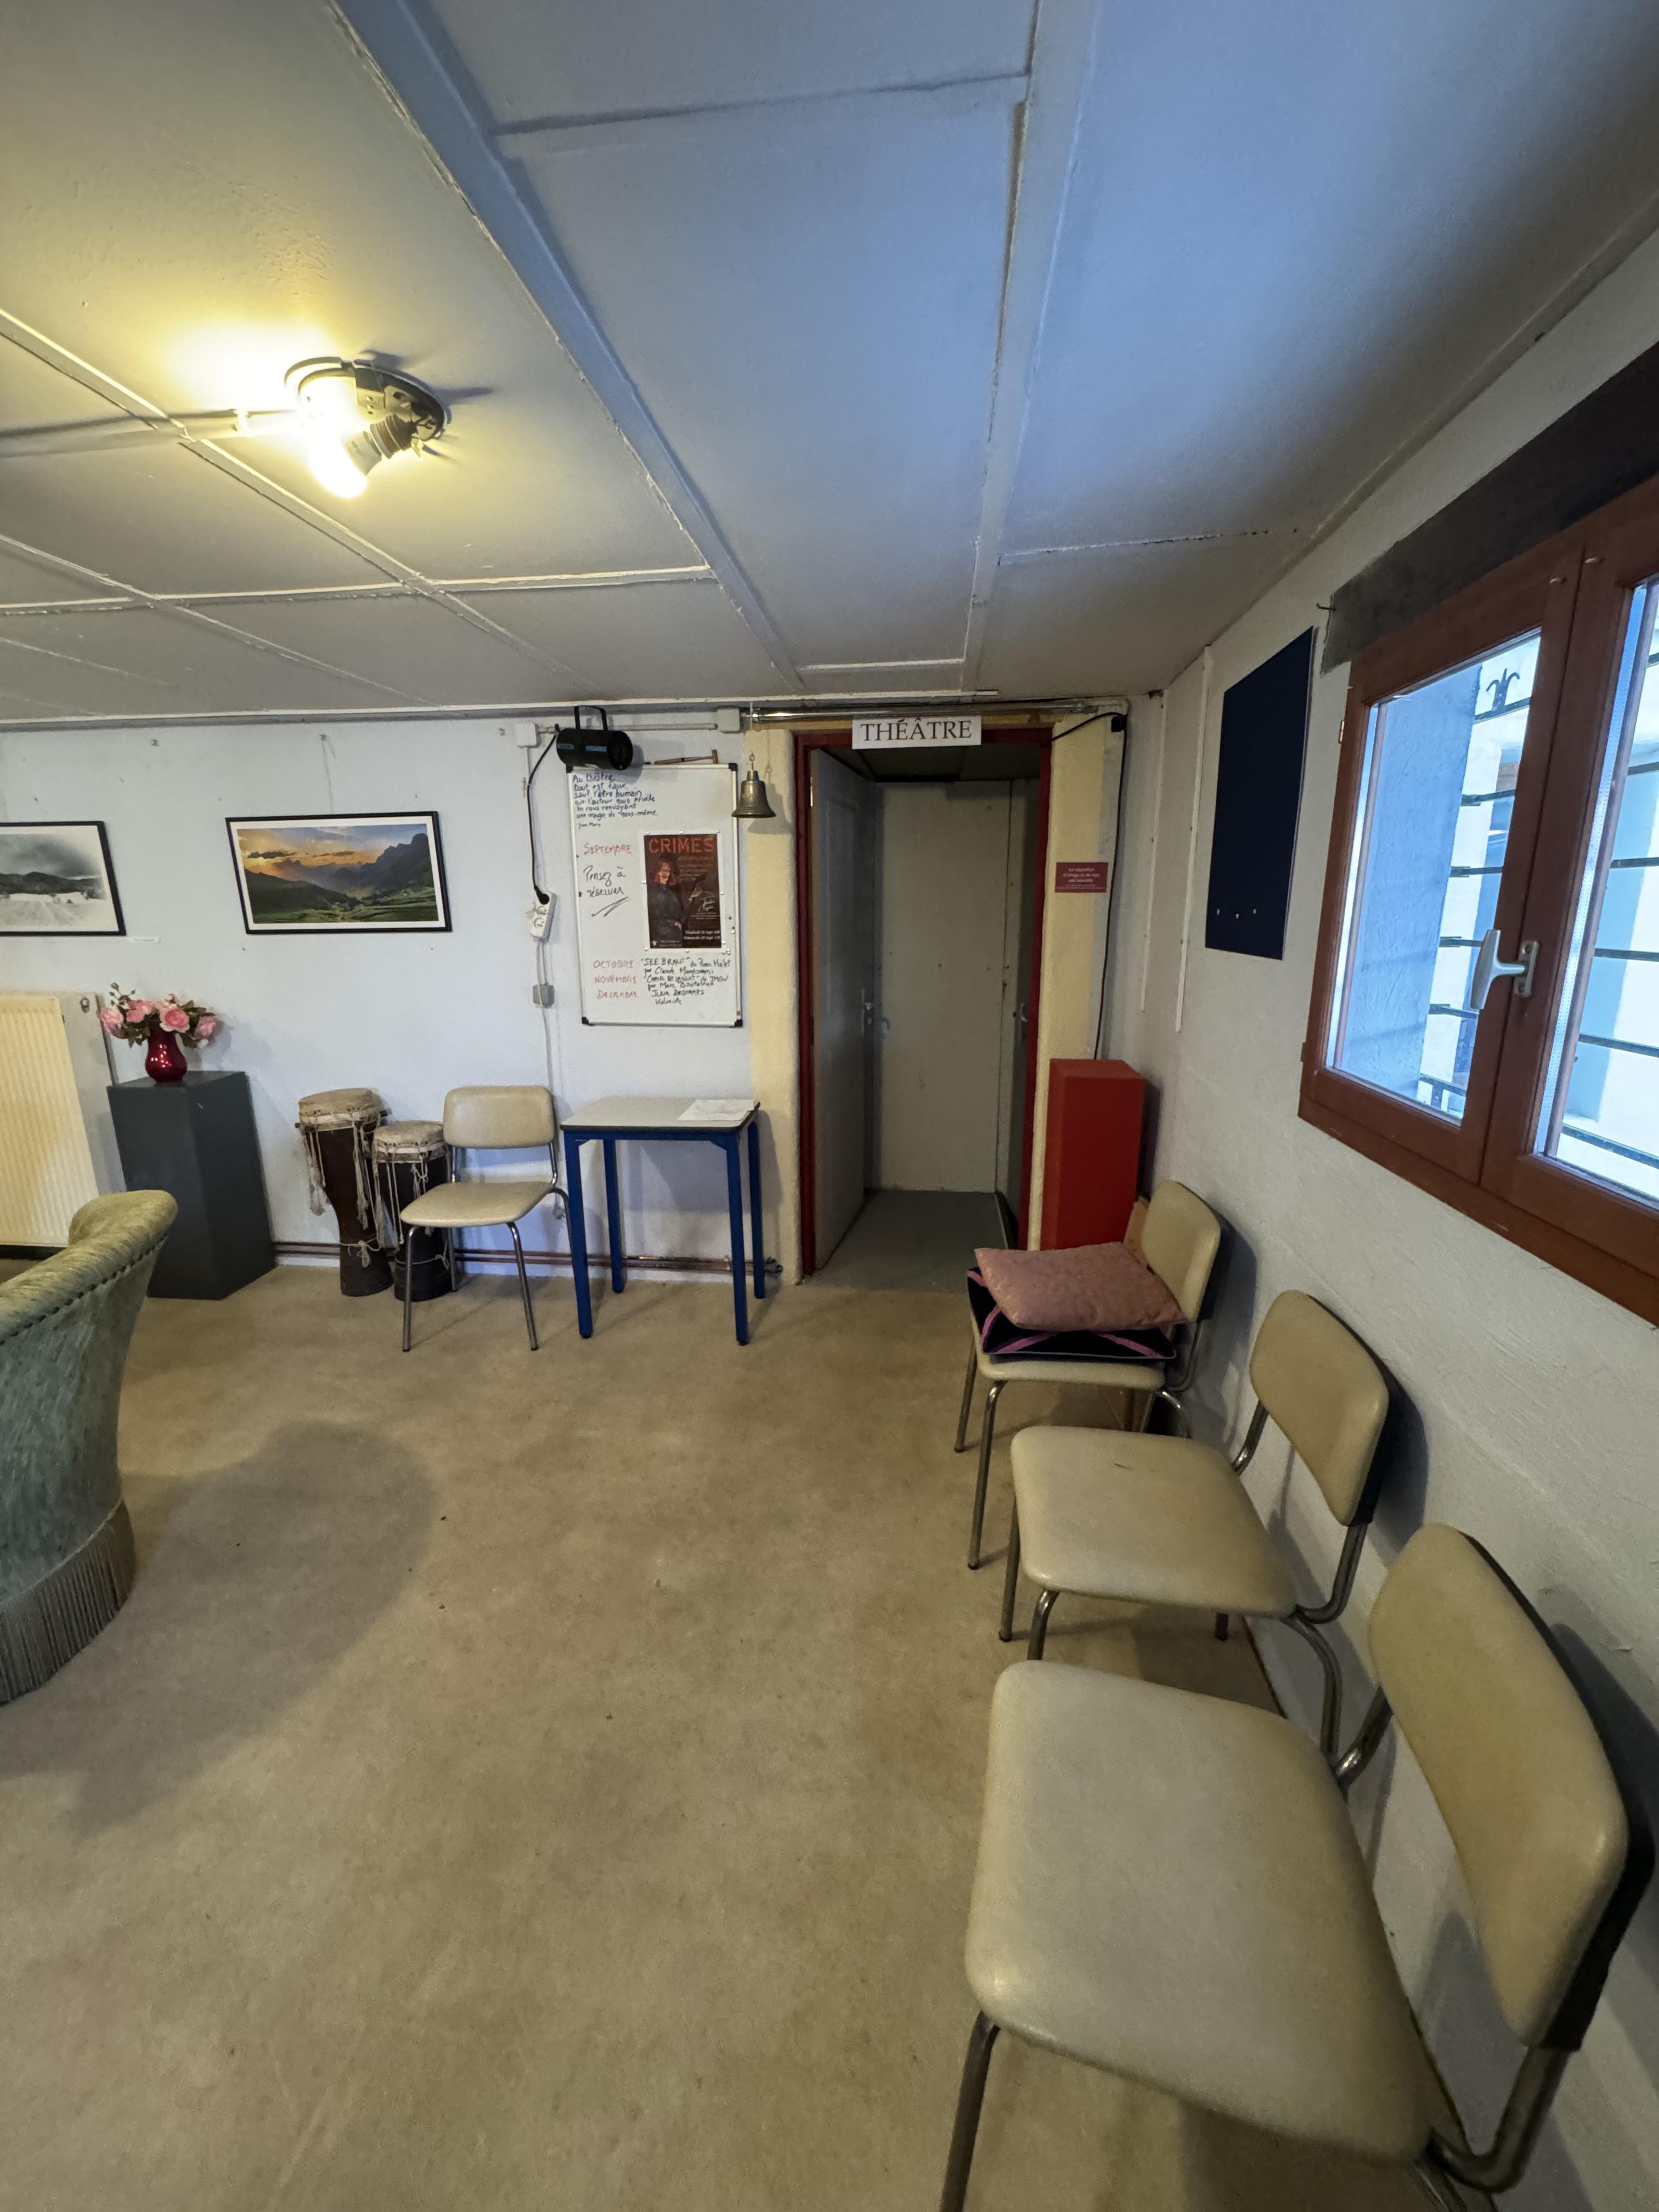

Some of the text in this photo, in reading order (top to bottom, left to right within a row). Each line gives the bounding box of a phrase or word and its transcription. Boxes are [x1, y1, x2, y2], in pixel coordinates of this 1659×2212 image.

[860, 717, 972, 741] THÉÂTRE
[616, 789, 642, 798] humain
[584, 843, 632, 855] SEPTEMBRE
[648, 838, 714, 853] CRIMES
[583, 865, 626, 887] Pensez à
[586, 886, 624, 897] réserver
[593, 960, 634, 968] OCTOBRE
[595, 975, 636, 984] NOVEMBRE
